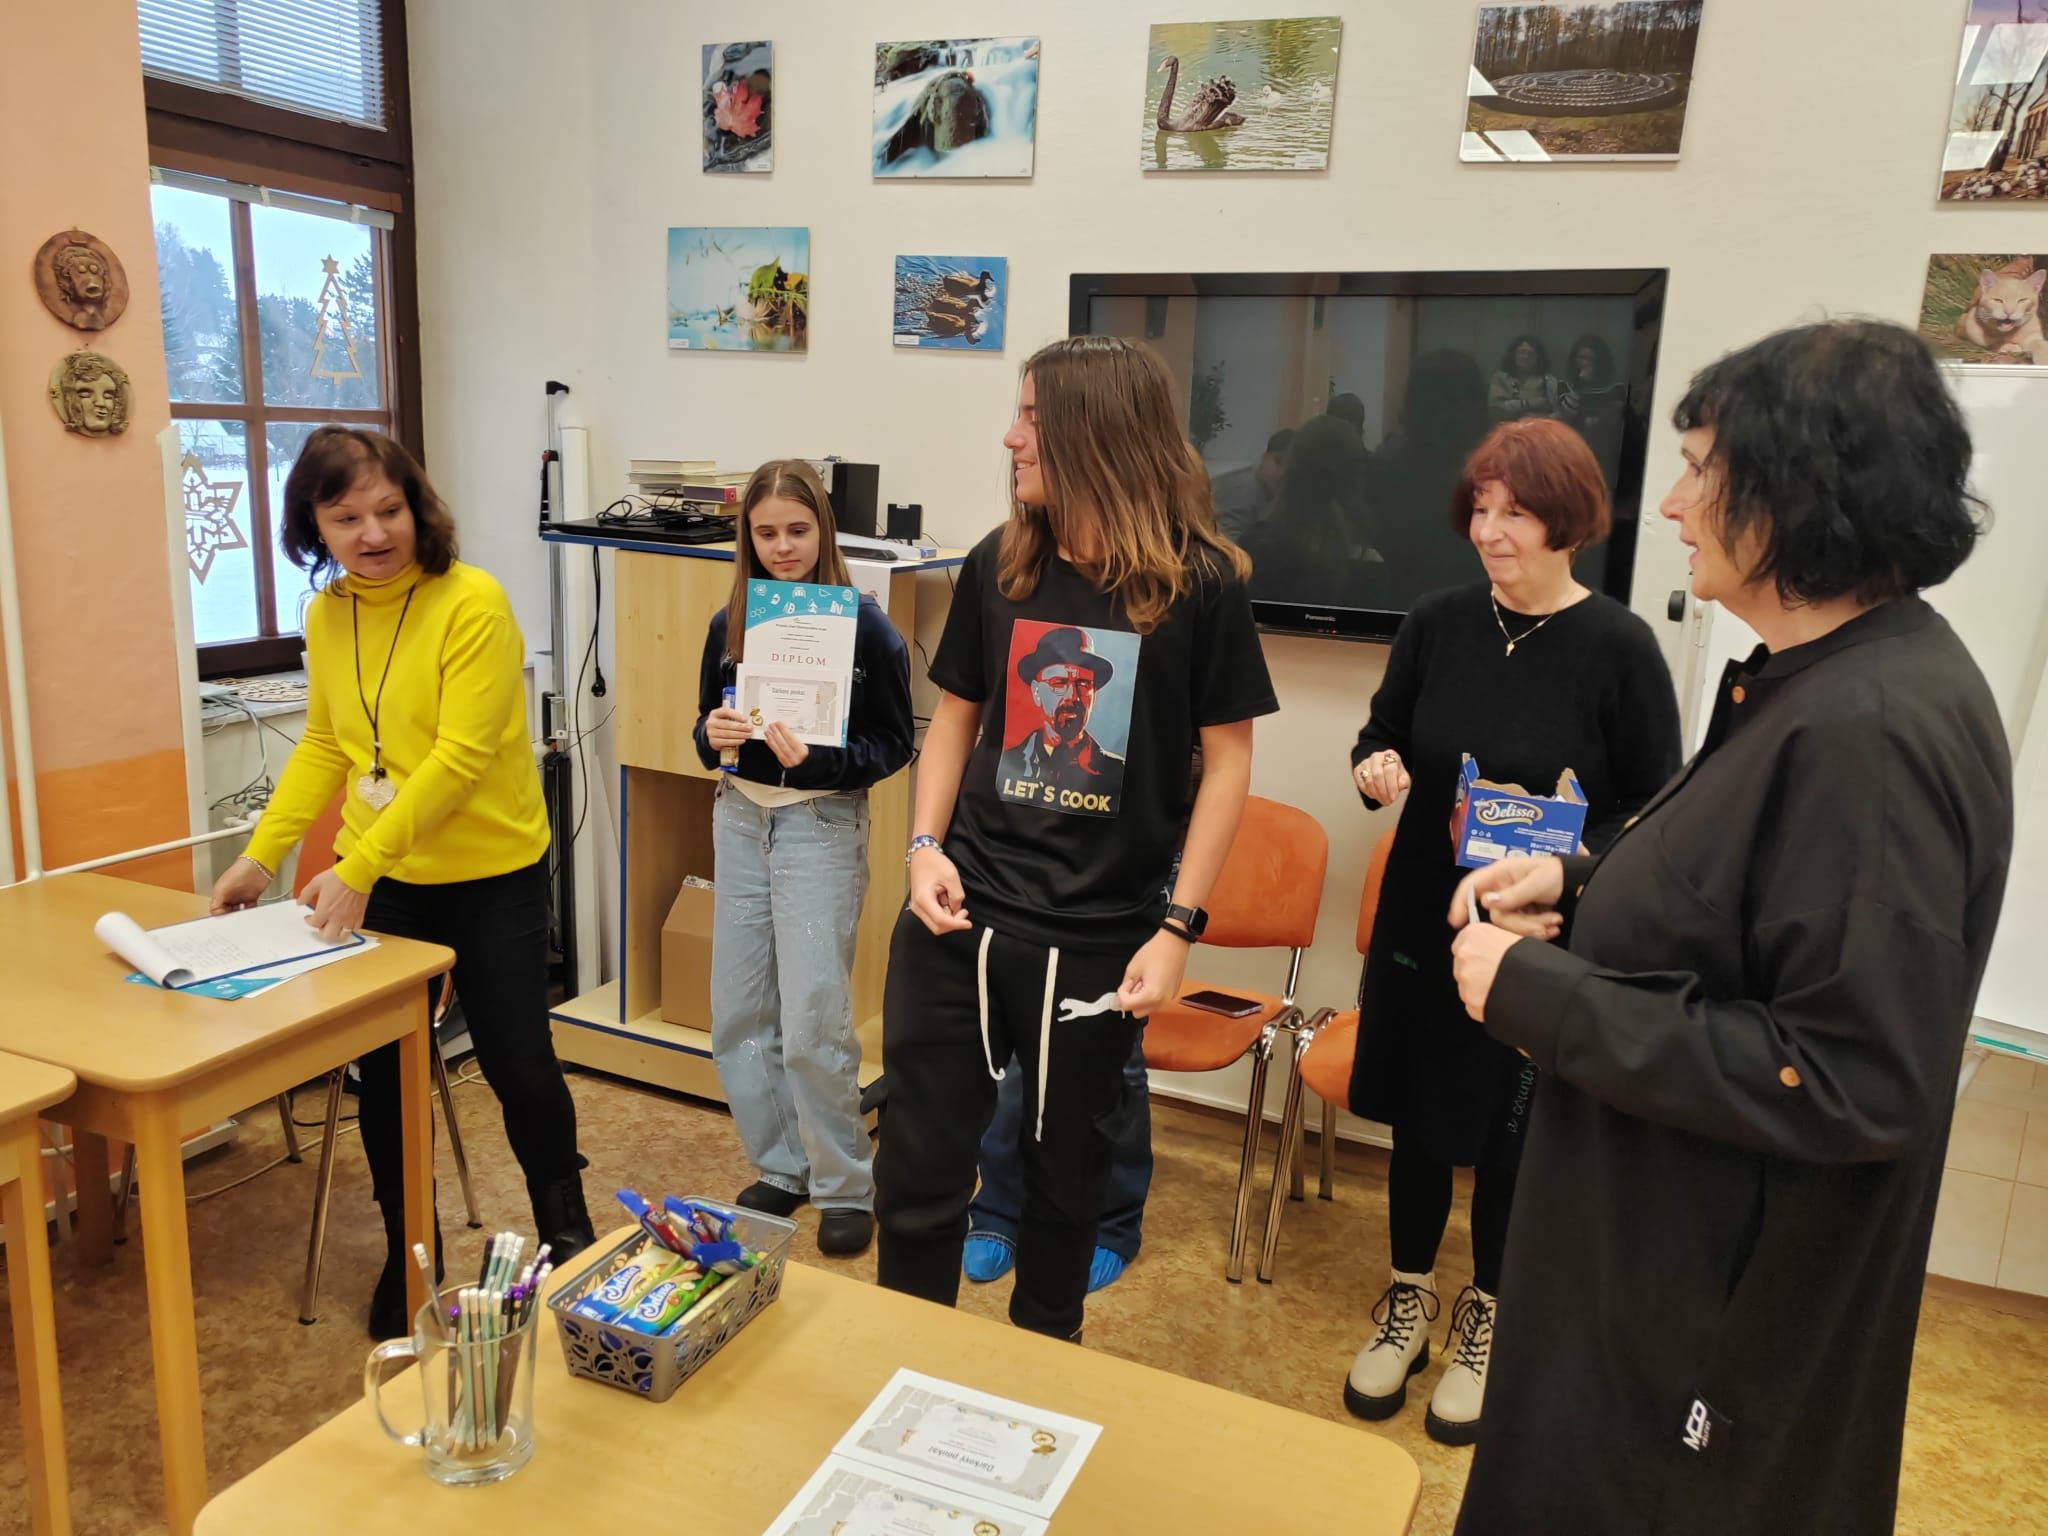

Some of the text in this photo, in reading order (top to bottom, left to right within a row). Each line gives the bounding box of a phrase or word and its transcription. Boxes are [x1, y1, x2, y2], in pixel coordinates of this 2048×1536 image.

[771, 653, 827, 666] DIPLOM
[1059, 789, 1112, 812] COOK
[1482, 802, 1535, 820] Delissa
